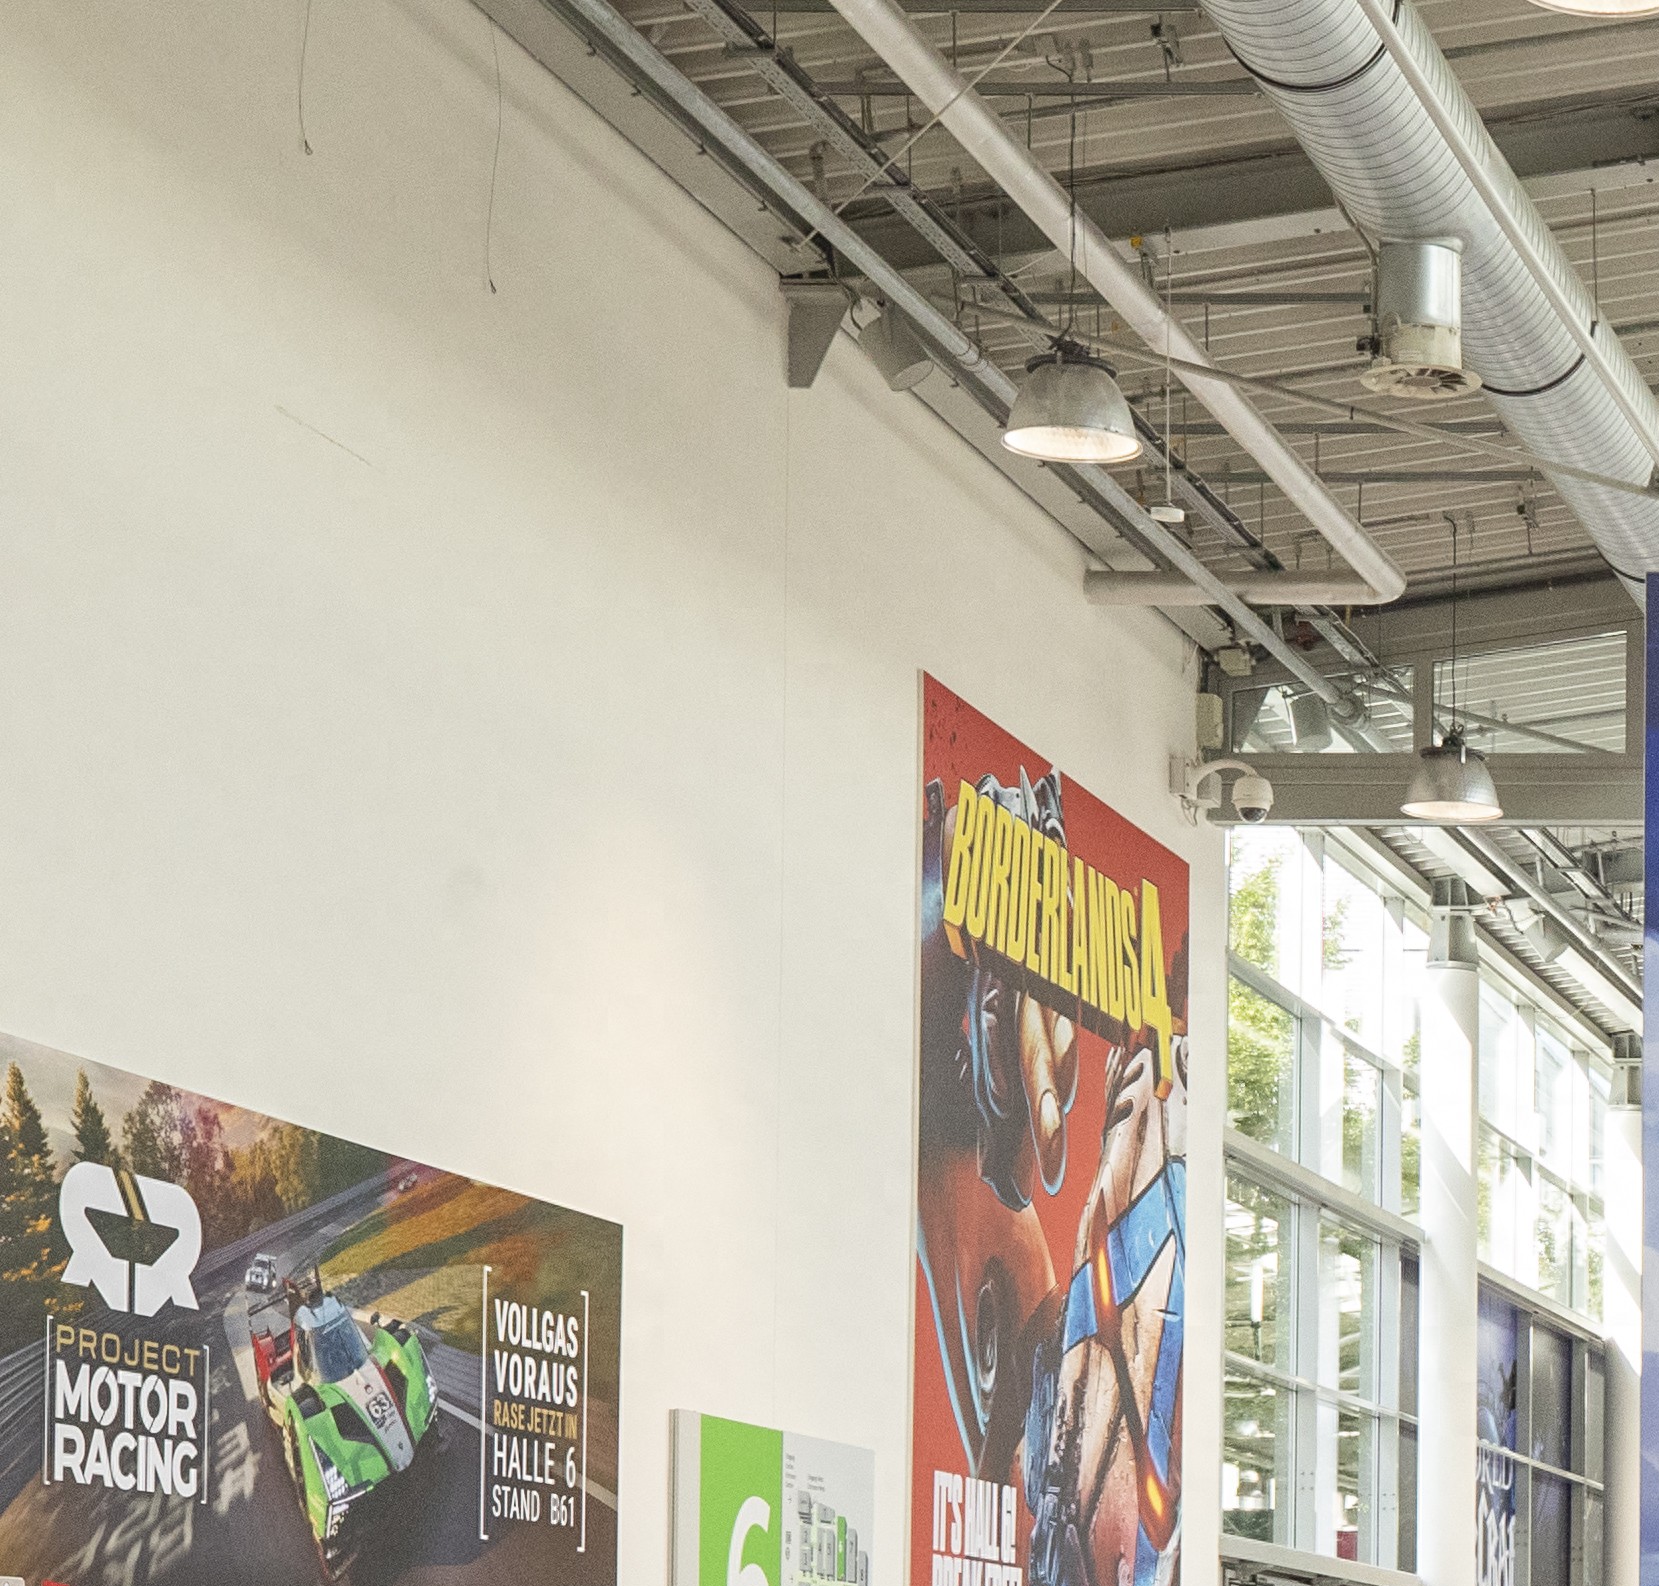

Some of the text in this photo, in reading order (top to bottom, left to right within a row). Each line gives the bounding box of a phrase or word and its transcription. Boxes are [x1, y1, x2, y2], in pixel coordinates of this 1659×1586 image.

[943, 779, 1172, 1080] BORDERLANDS 4
[56, 1324, 200, 1376] PROJECT
[495, 1298, 578, 1358] VOLLGAS
[55, 1359, 197, 1439] MOTOR
[494, 1349, 578, 1407] VORAUS
[494, 1399, 578, 1439] RASE JETZT IN
[54, 1423, 198, 1497] RACING
[494, 1432, 576, 1488] HALLE 6
[492, 1484, 575, 1527] STAND B61
[964, 1476, 999, 1560] HALL
